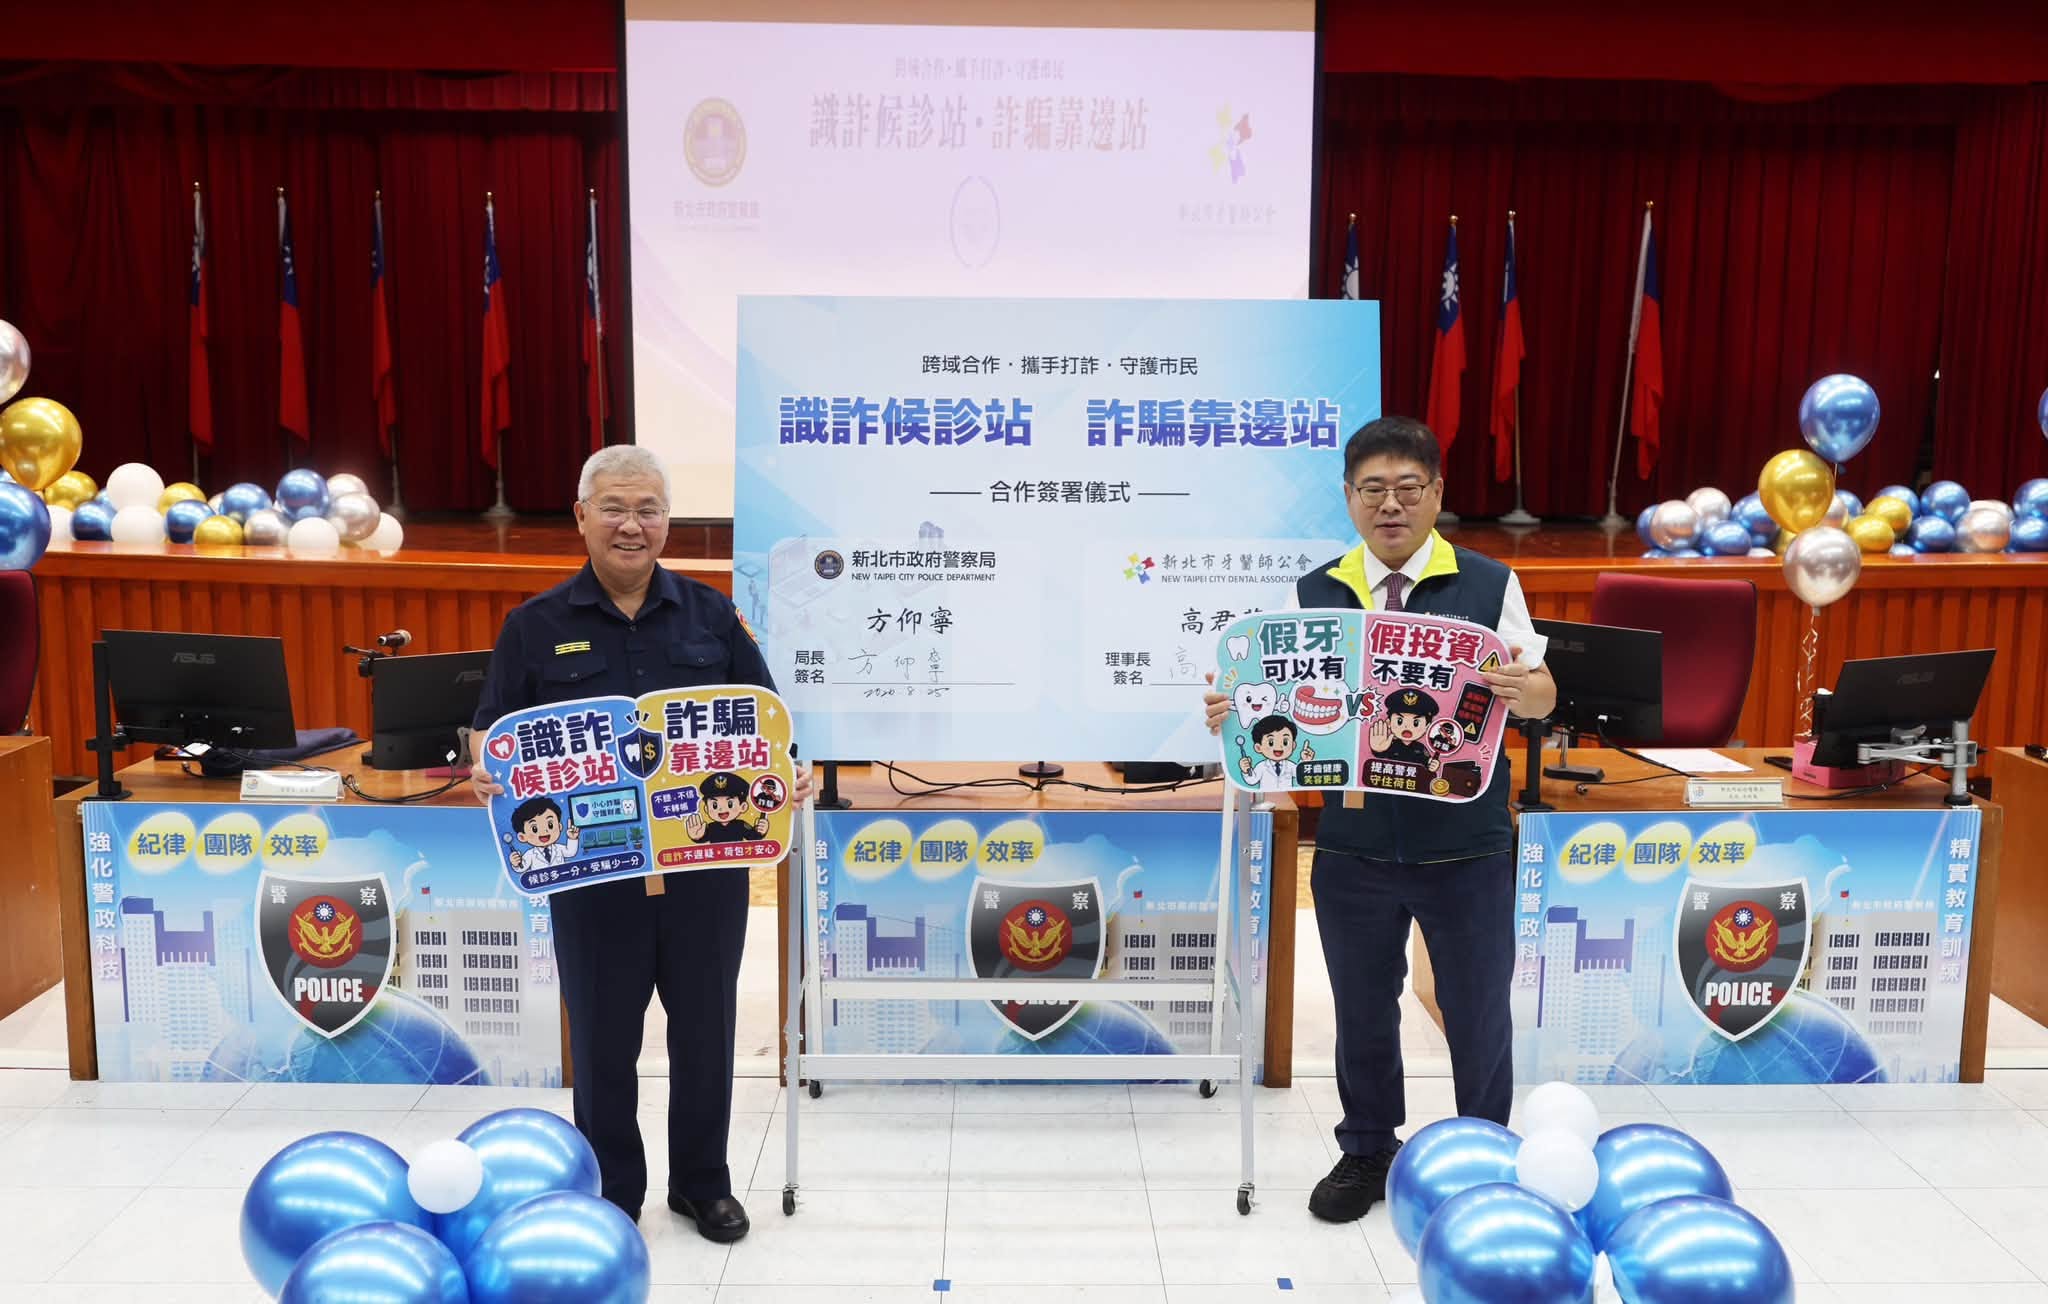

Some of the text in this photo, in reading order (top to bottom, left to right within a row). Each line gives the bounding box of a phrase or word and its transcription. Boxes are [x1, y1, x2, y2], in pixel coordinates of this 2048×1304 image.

[779, 396, 1340, 449] 識詐候診站 詐騙靠邊站
[990, 480, 1131, 504] 合作簽署儀式
[852, 551, 996, 568] 新北市政府警察局
[1162, 553, 1312, 571] 新北市牙醫師公會
[851, 573, 996, 581] NEW TAIPEI CITY POLICE DEPARTMENT
[867, 606, 953, 634] 方仰寧
[1181, 607, 1263, 634] 高君
[1259, 618, 1341, 655] 假牙
[1371, 622, 1483, 665] 假投資
[172, 653, 217, 665] ASUS
[795, 651, 825, 665] 局長
[1105, 652, 1151, 667] 理事長
[1262, 657, 1346, 682] 可以有
[795, 669, 825, 684] 簽名
[1113, 671, 1144, 685] 簽名
[1372, 659, 1455, 690] 不要有
[1346, 691, 1376, 717] VS
[664, 698, 757, 740] 詐騙
[516, 711, 614, 762] 識詐
[669, 738, 770, 774] 靠邊站
[510, 752, 617, 797] 候診站
[1370, 761, 1417, 778] 提高警覺
[1370, 774, 1417, 791] 守住荷包
[136, 832, 320, 858] 紀律 團隊 效率
[853, 840, 1035, 863] 紀律 團隊 效率
[1568, 841, 1745, 866] 紀律 團隊 效率
[88, 832, 120, 980] 強化警政科技
[270, 885, 377, 906] 警 察
[983, 891, 1089, 910] 警 察
[1693, 891, 1797, 911] 警 察
[1518, 843, 1544, 987] 強化警政科技
[1940, 838, 1972, 983] 精實教育訓練
[294, 977, 363, 1002] POLICE
[1706, 982, 1772, 1007] POLICE
